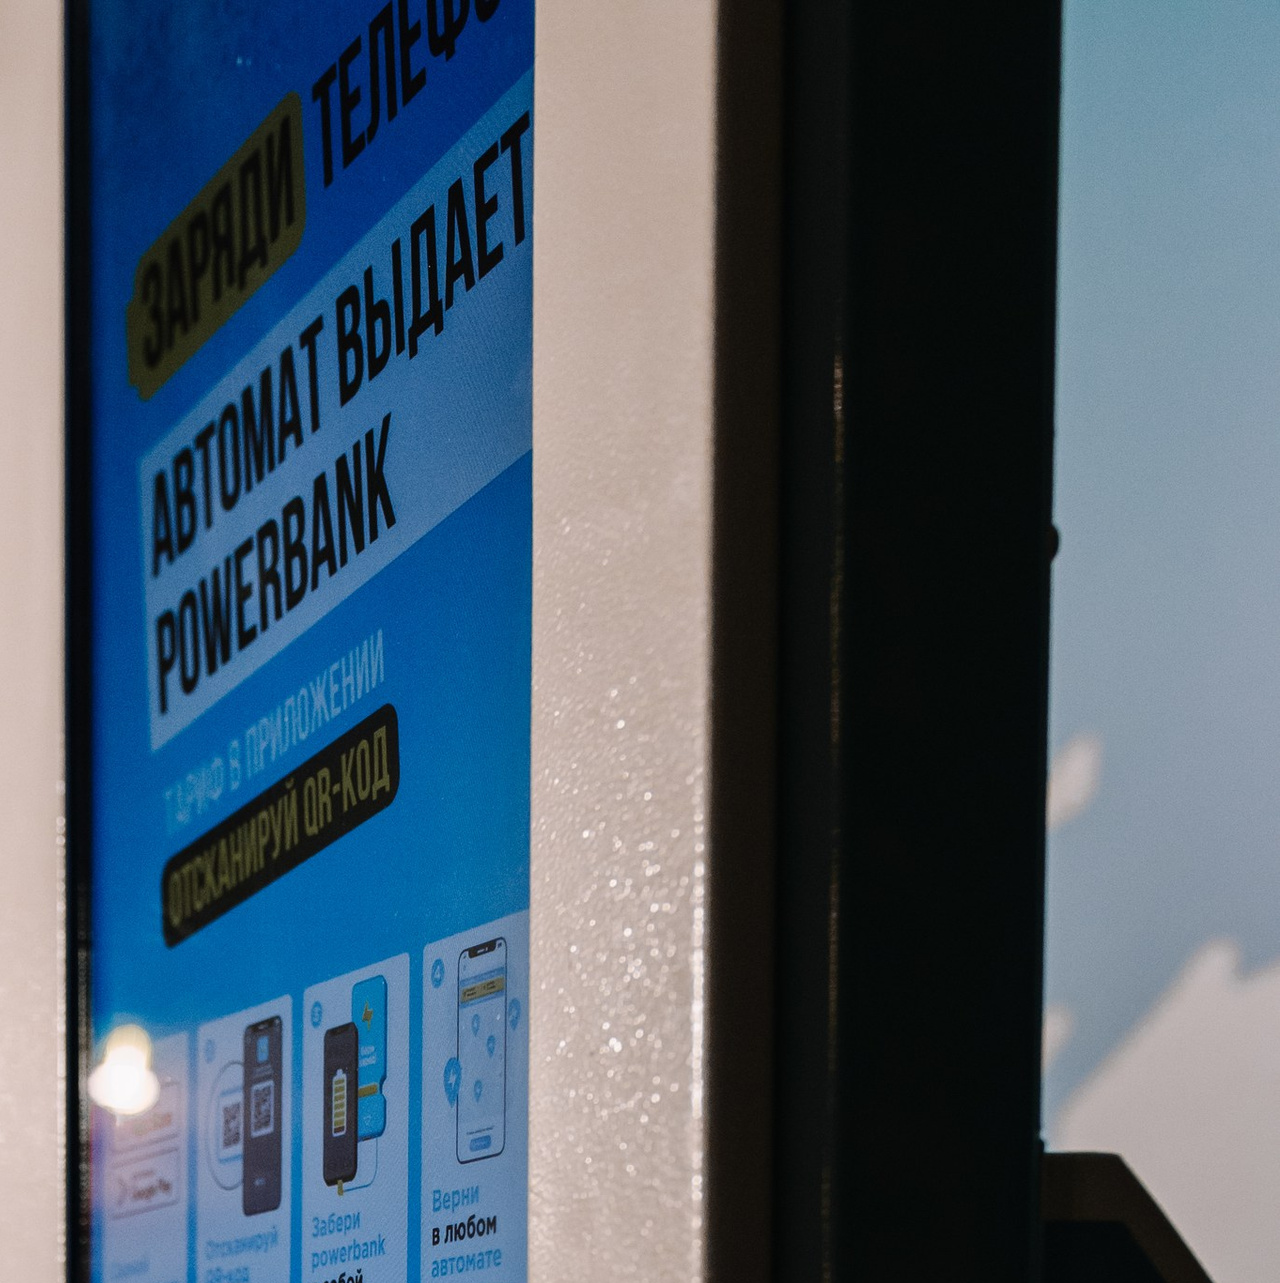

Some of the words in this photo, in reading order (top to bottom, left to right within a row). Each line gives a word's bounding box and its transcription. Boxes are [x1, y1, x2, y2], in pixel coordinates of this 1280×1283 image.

[141, 114, 296, 370] ЗАРЯДИ
[312, 0, 501, 189] ТЕЛЕФ
[153, 315, 324, 577] АВТОМАТ
[336, 110, 530, 408] ВЫДАЕТ
[155, 412, 397, 715] POWERBANK
[228, 741, 241, 789] В
[245, 629, 386, 779] ПРИЛОЖЕНИИ
[168, 778, 300, 927] ОТСКАНИРУЙ
[304, 726, 391, 834] QR-КОД
[312, 1211, 361, 1238] Забери
[432, 1185, 480, 1213] Верни
[432, 1227, 441, 1246] в
[444, 1214, 497, 1244] любом
[312, 1234, 386, 1273] powerbank
[431, 1248, 502, 1278] автомате
